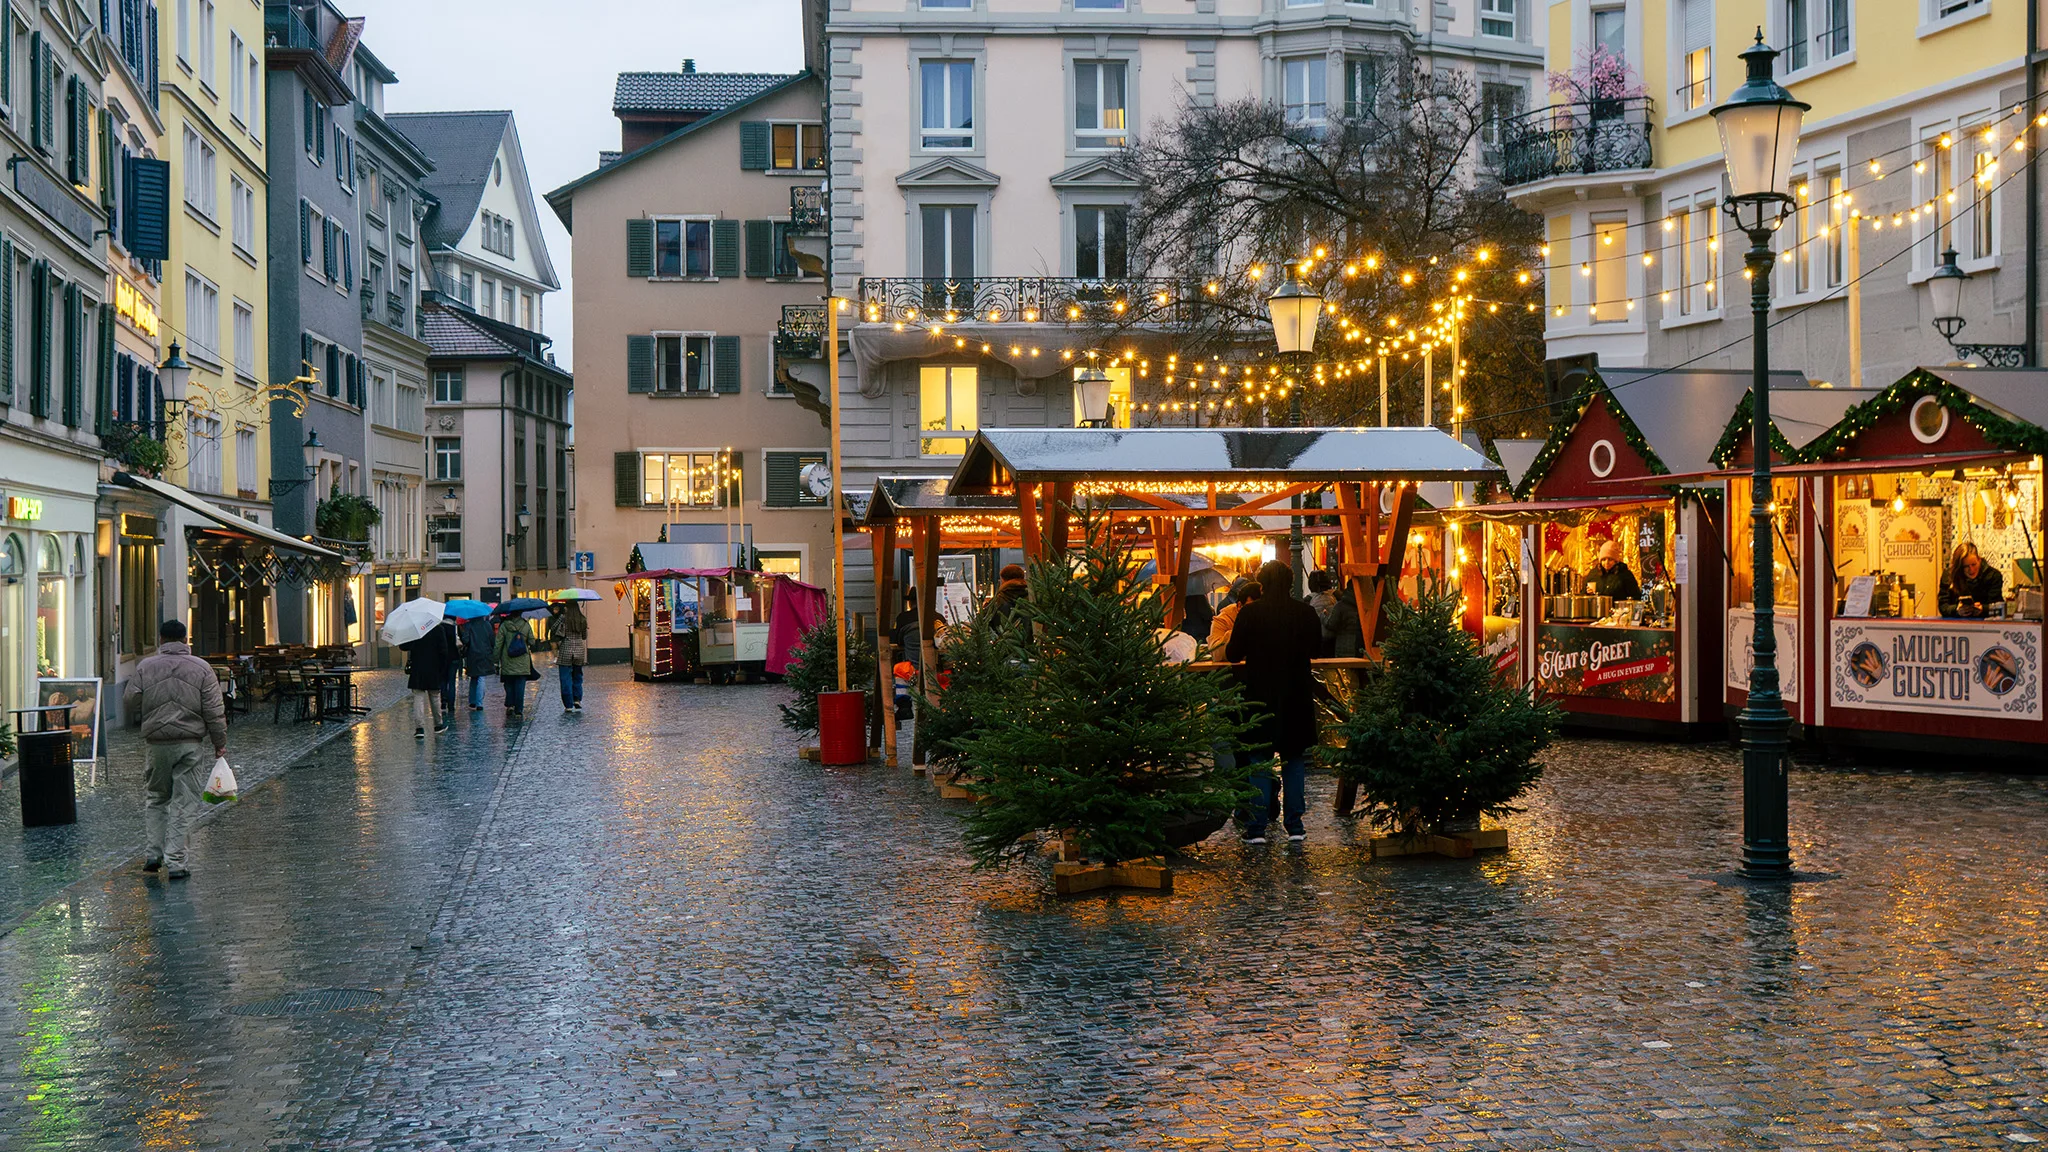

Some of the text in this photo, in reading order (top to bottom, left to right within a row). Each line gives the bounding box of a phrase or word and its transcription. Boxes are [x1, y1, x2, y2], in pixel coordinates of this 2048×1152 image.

[1887, 543, 1931, 557] CHURROS
[1580, 650, 1589, 666] &
[1893, 634, 1970, 664] ¡MUCHO
[1602, 670, 1617, 680] HUG
[1617, 668, 1625, 677] IN
[1625, 664, 1644, 676] EVERY
[1644, 662, 1655, 672] SIP
[1893, 665, 1970, 701] GUSTO!
